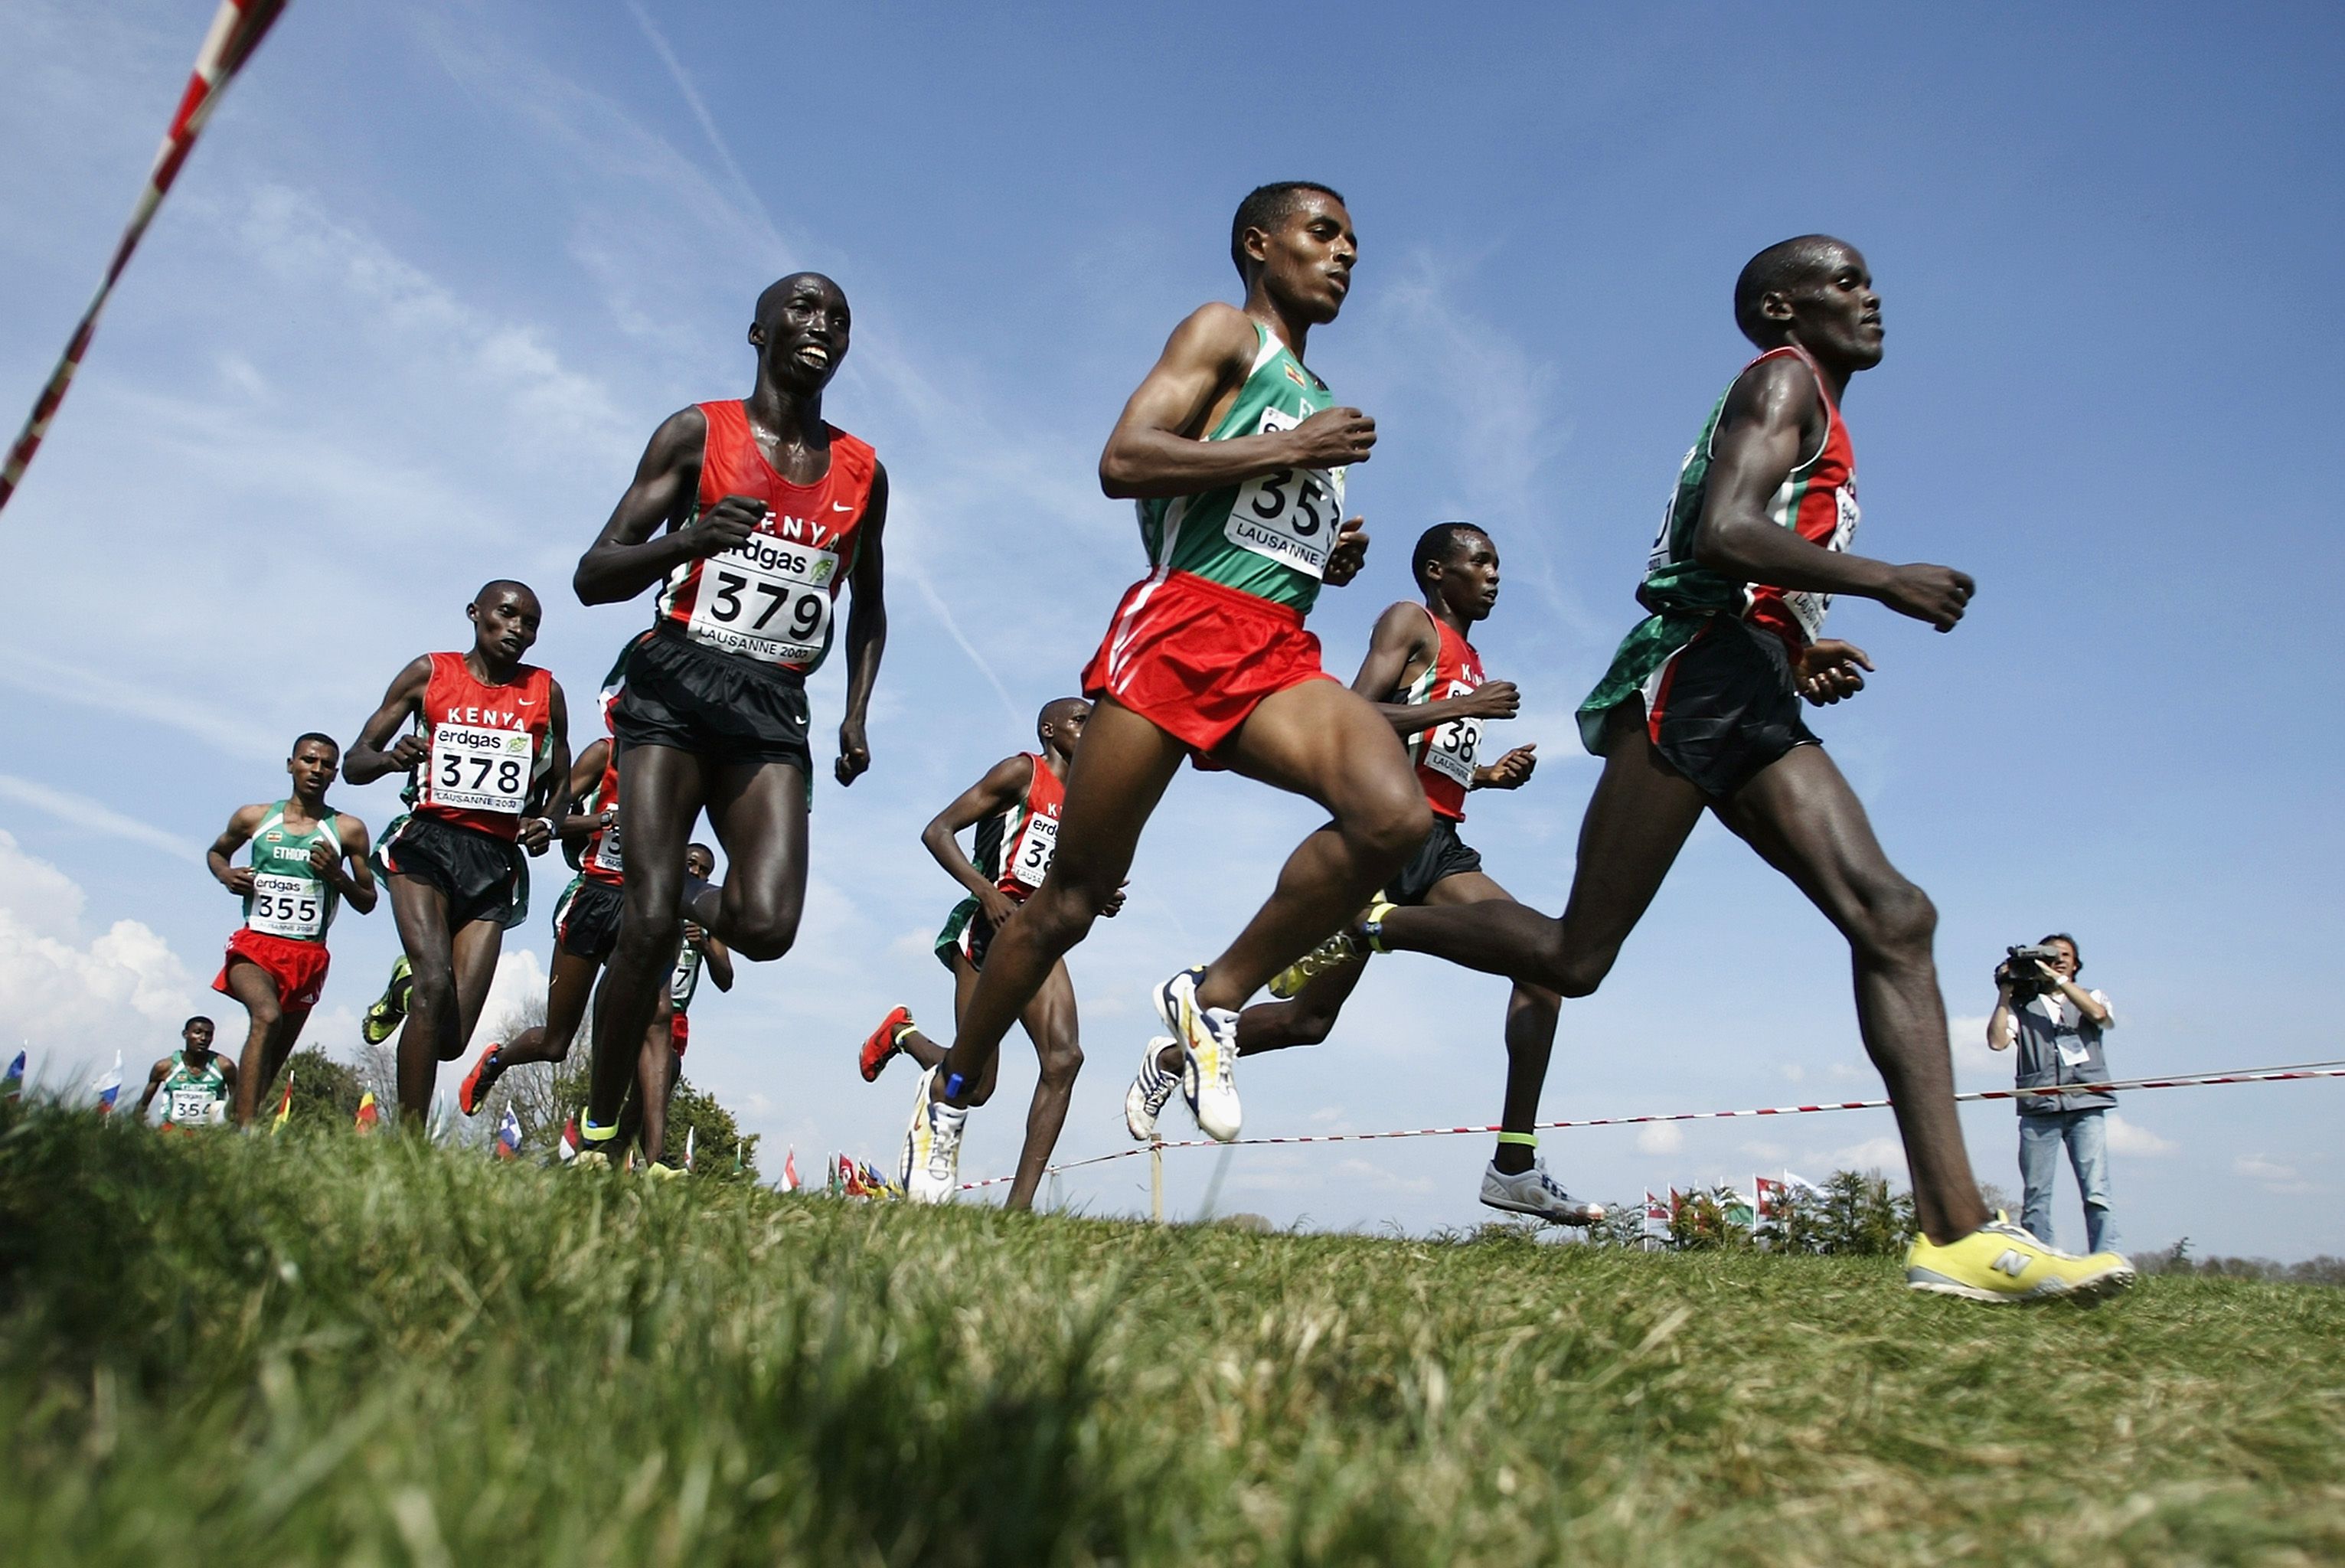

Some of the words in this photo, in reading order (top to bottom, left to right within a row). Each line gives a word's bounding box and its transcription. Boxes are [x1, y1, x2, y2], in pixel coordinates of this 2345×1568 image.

[760, 511, 841, 553] ENYA
[1236, 523, 1319, 564] LAUSANNE
[710, 571, 823, 642] 379
[698, 626, 777, 655] LAUSANNE
[448, 707, 525, 733] KENYA
[438, 730, 501, 749] erdgas
[441, 753, 521, 794] 378
[436, 792, 492, 806] LAUSANNE
[1033, 818, 1057, 840] erd
[256, 878, 301, 893] erdgas
[259, 894, 315, 922] 355
